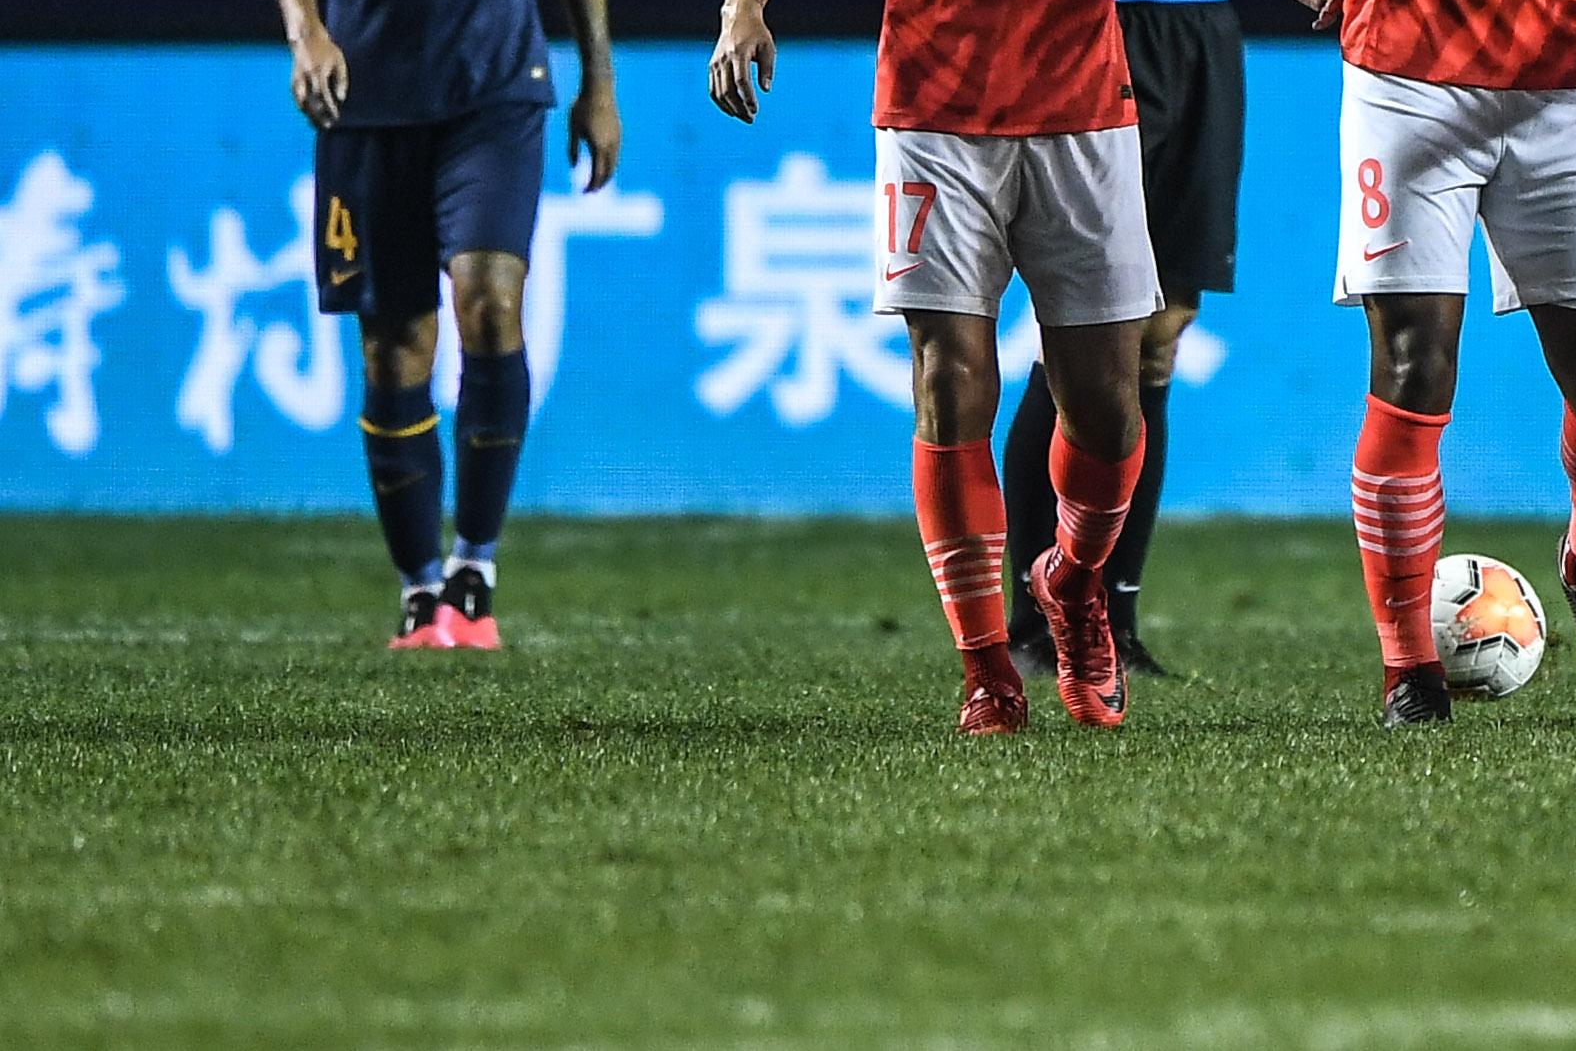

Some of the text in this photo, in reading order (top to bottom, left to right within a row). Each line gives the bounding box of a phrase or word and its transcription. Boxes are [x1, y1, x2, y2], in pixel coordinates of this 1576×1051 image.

[325, 195, 358, 261] 4
[884, 181, 937, 254] 17
[1358, 158, 1390, 229] 8
